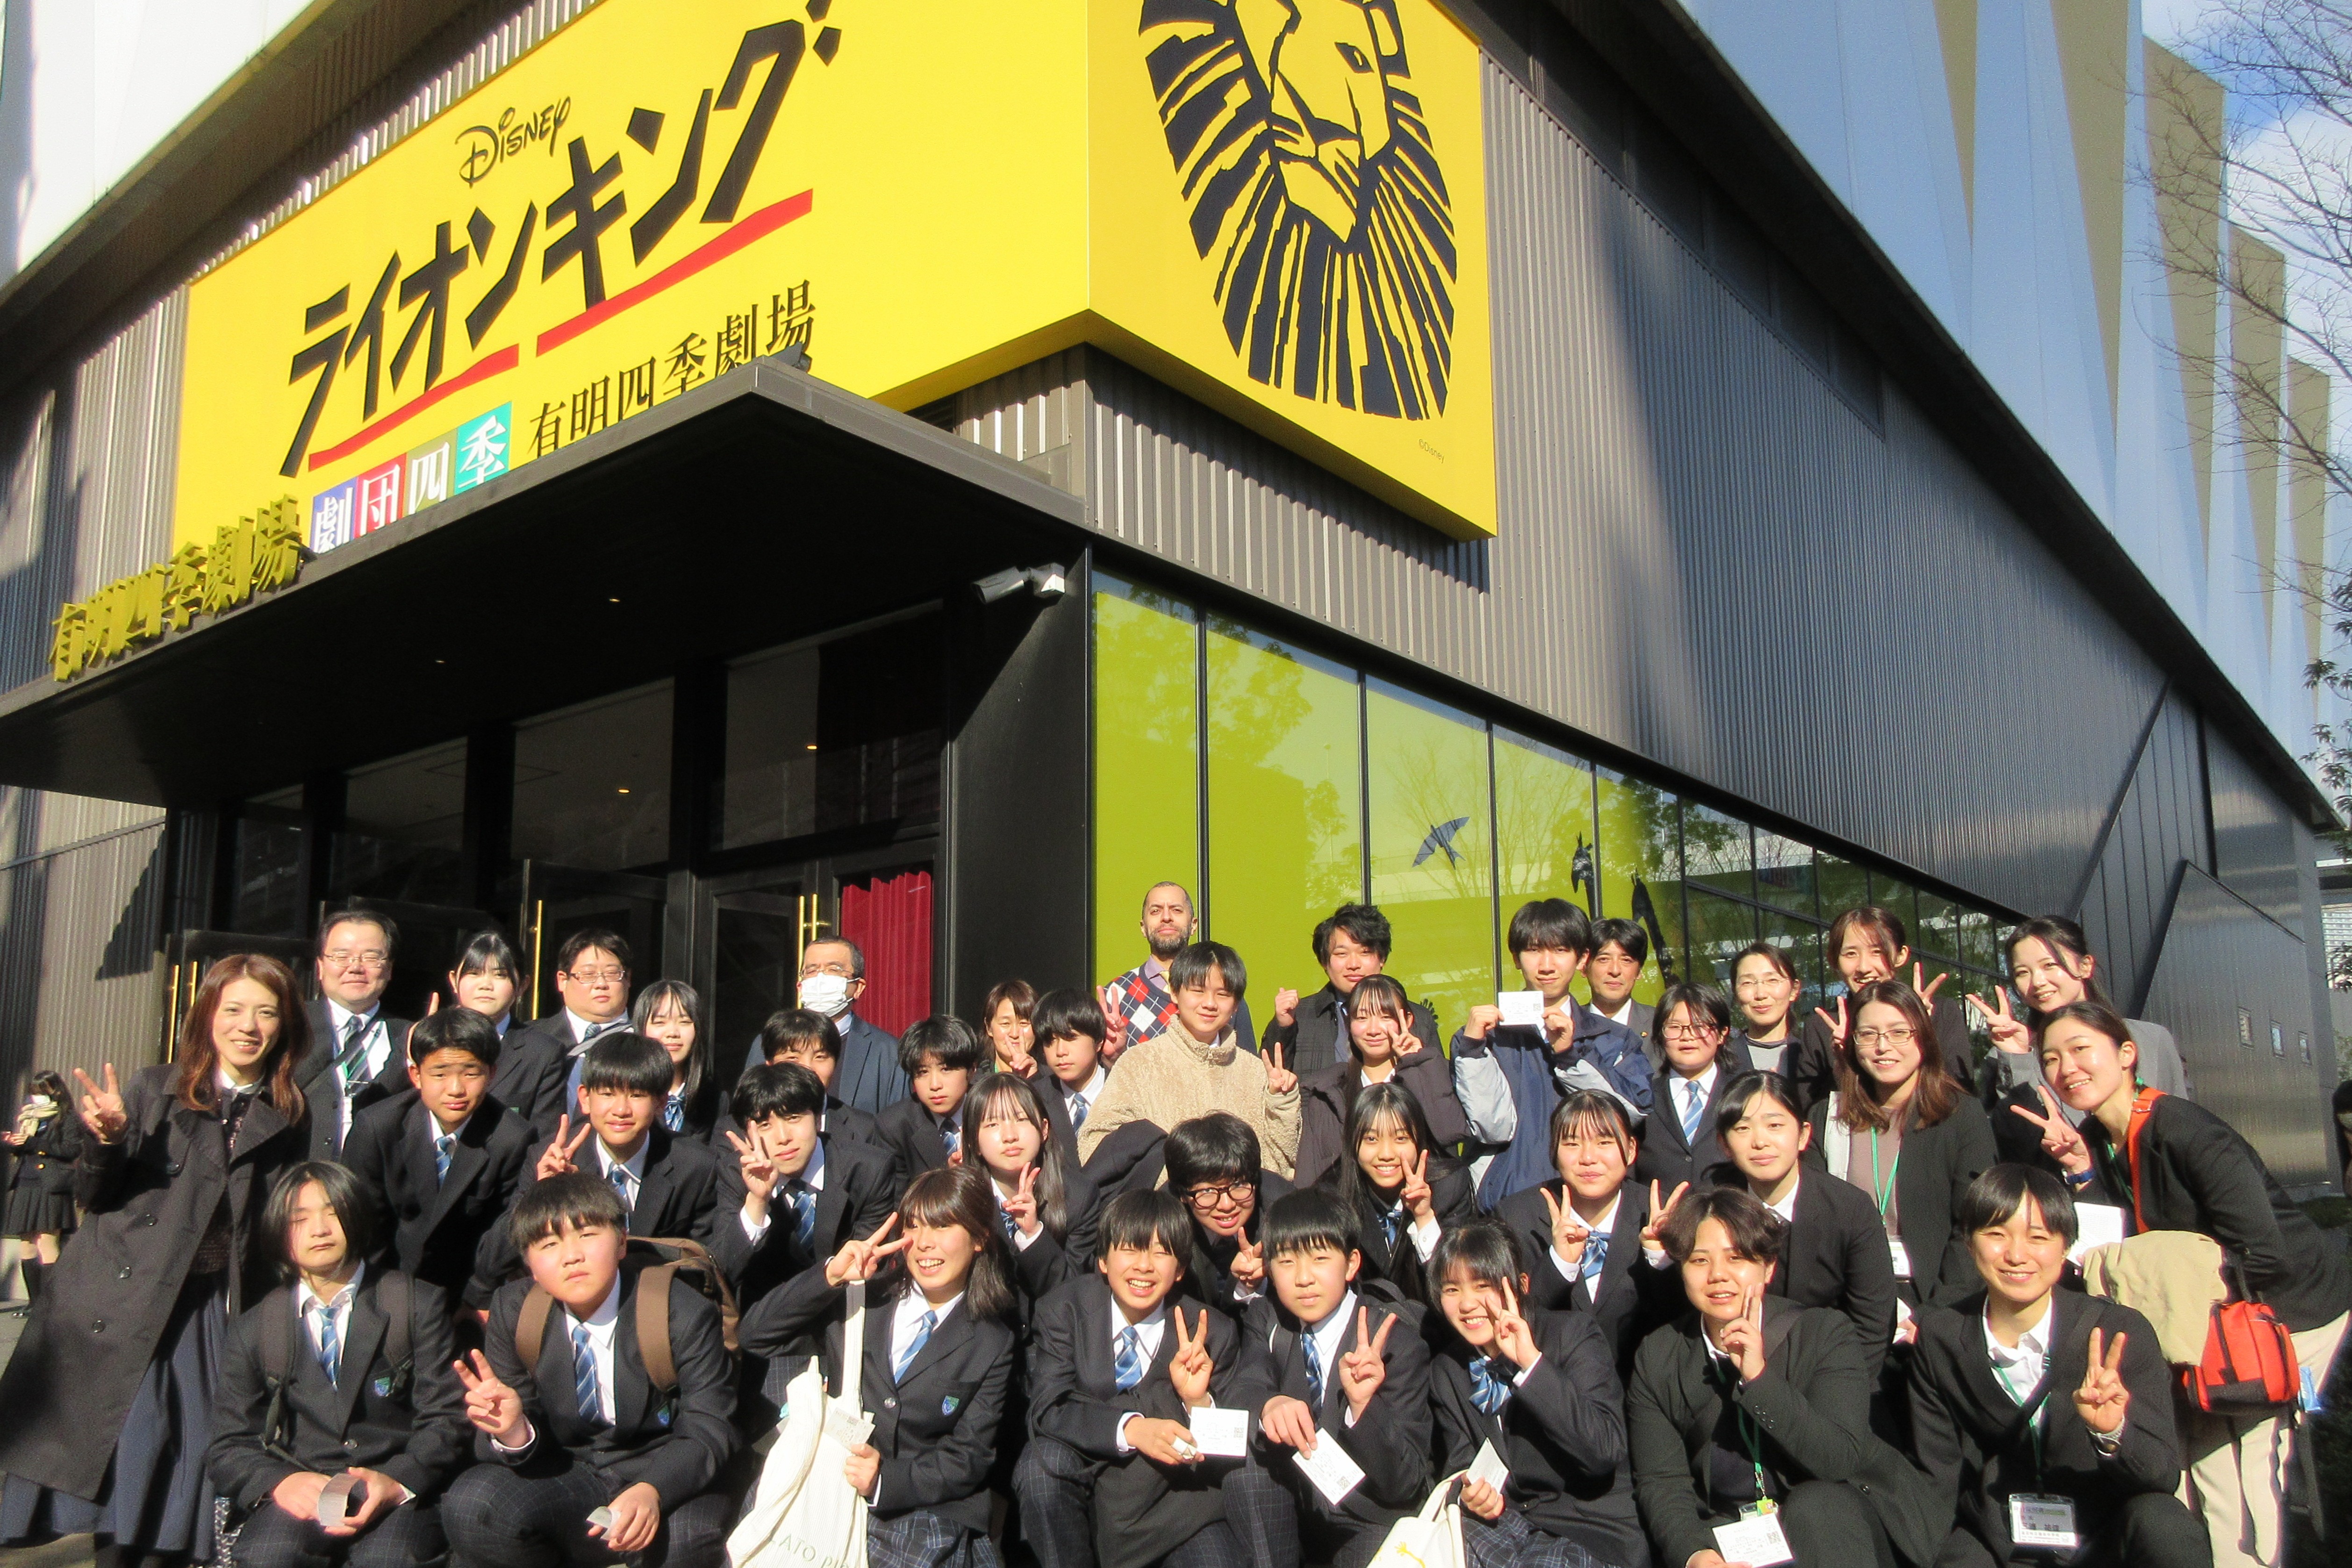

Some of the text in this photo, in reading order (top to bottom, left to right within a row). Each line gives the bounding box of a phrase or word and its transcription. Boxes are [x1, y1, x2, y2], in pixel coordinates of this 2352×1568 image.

[281, 0, 842, 478] ライオンキング
[527, 279, 816, 458] 有明四季劇場
[314, 415, 507, 554] 劇団四季
[49, 494, 302, 681] 有明四季劇場
